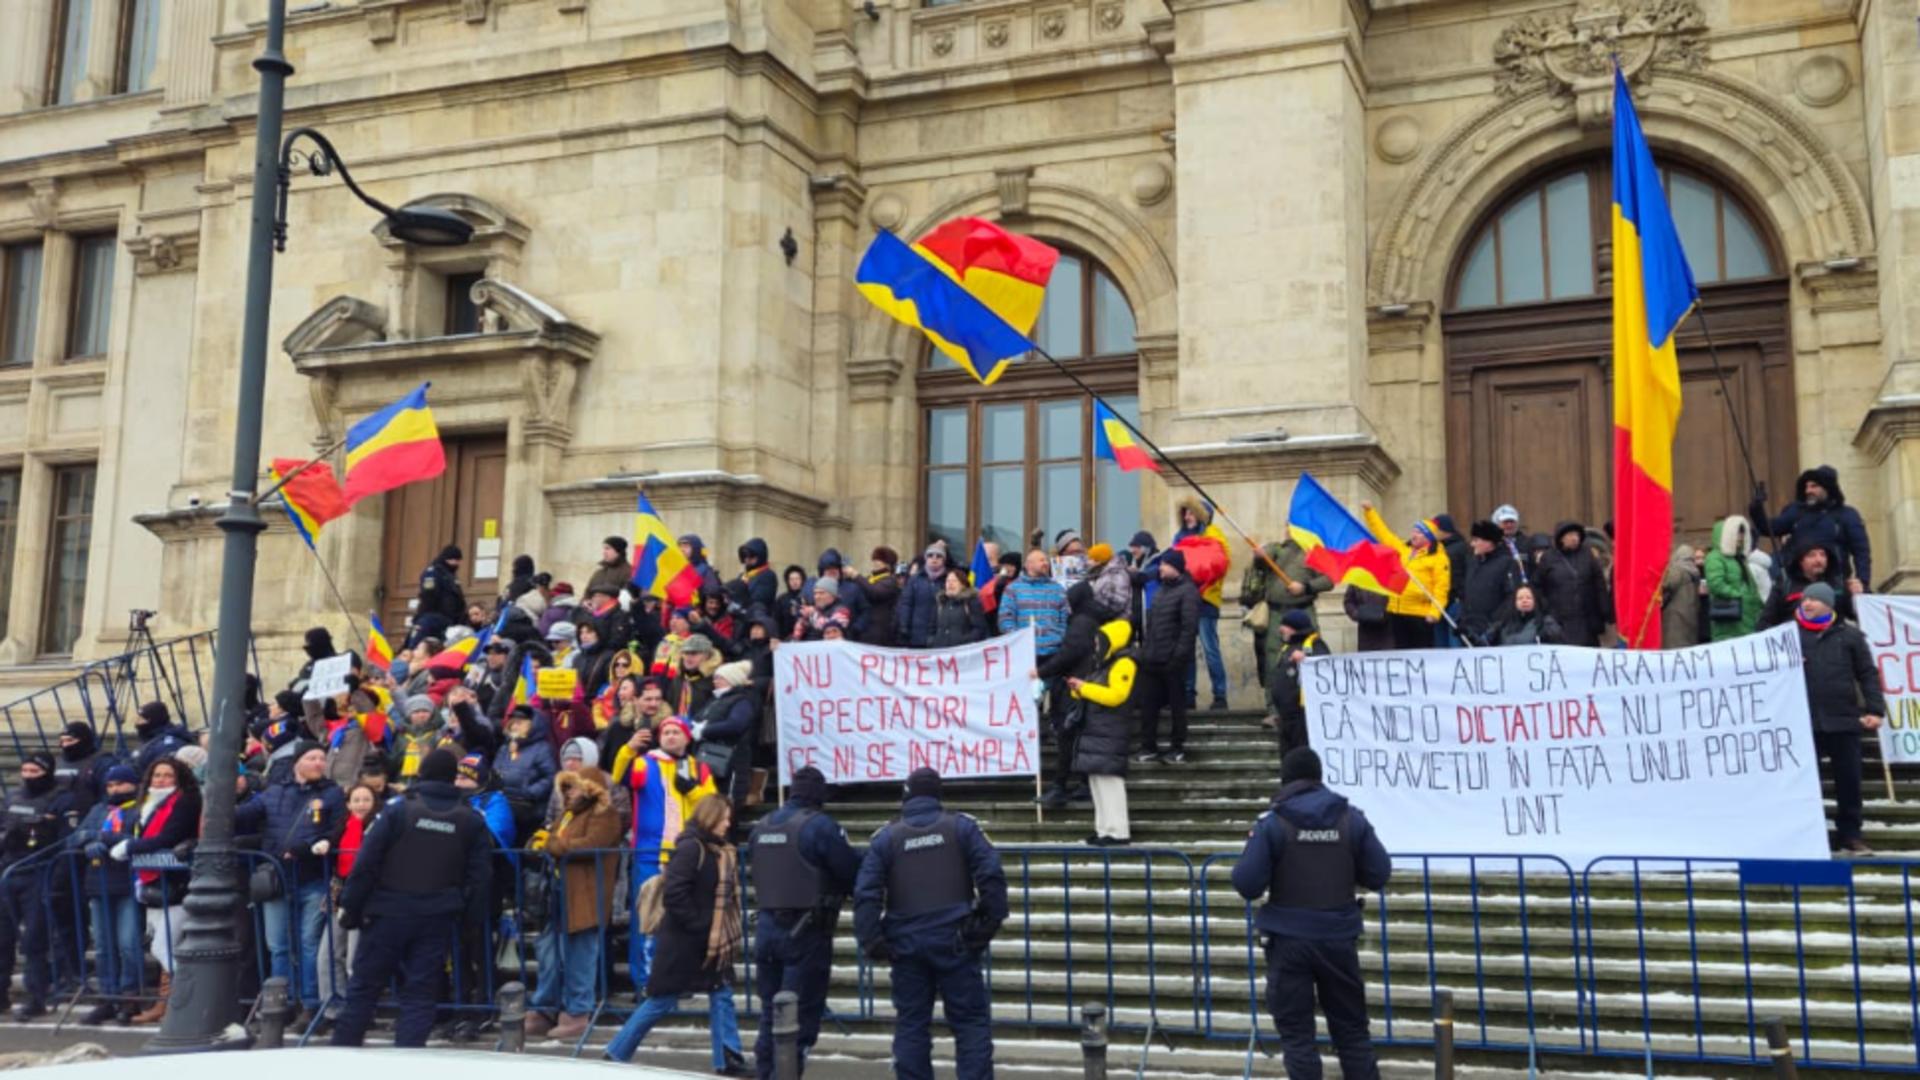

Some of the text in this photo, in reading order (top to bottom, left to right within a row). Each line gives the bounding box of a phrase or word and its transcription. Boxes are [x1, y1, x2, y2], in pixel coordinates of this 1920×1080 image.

[860, 653, 960, 687] PUTEM
[982, 645, 1010, 681] FI
[1314, 657, 1428, 697] SUNTEM
[1450, 654, 1505, 695] AICI
[1528, 649, 1567, 693] SĂ
[1731, 629, 1800, 676] LUMII
[801, 691, 1025, 736] SPECTATORI LA
[1456, 693, 1606, 744] DICTATURĂ
[1621, 693, 1662, 735] NU
[1680, 680, 1771, 730] POATE
[834, 744, 855, 779] NI
[866, 742, 896, 778] SE
[1626, 738, 1690, 783] UNUI
[1704, 727, 1800, 778] POPOR
[1502, 794, 1564, 836] UNIT
